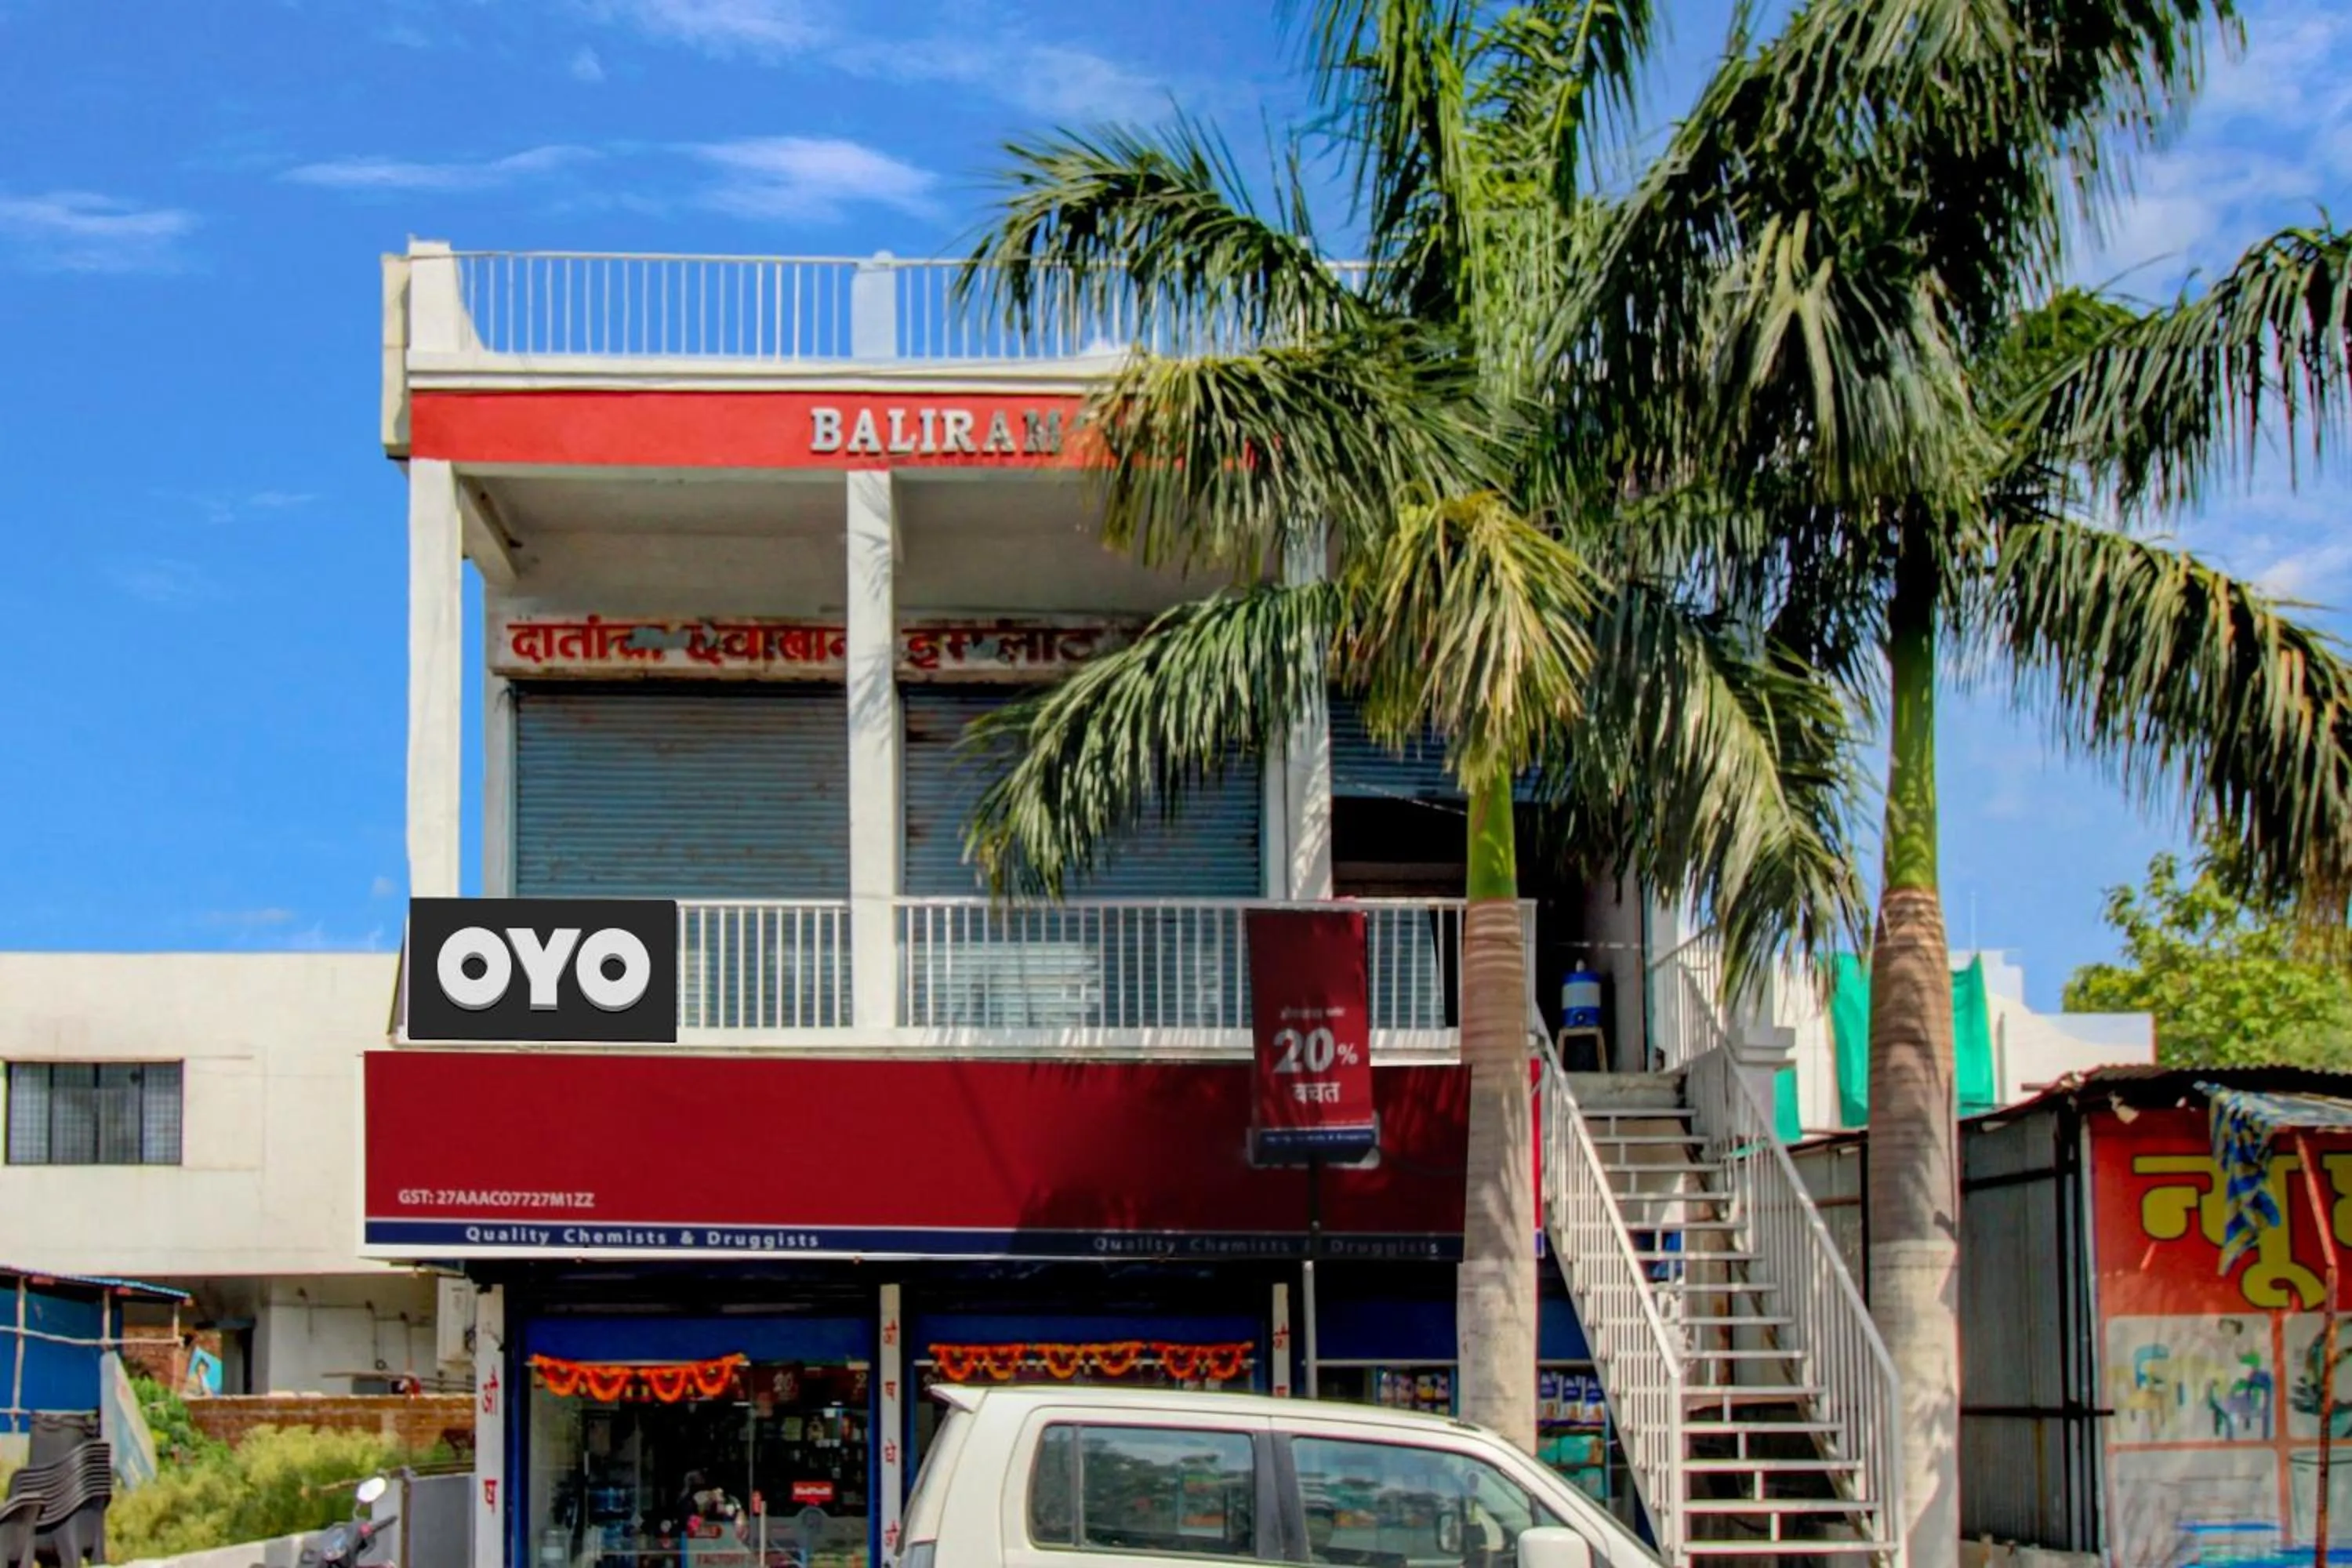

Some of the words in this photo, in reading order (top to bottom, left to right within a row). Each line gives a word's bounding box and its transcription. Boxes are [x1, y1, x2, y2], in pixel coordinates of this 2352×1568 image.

[810, 408, 1063, 456] BALIRAM
[437, 926, 652, 1013] OYO
[1272, 1026, 1359, 1073] 20%
[1291, 1081, 1341, 1105] बचत
[397, 1189, 434, 1205] GST:
[465, 1226, 550, 1246] Quality
[563, 1227, 667, 1245] Chemists
[680, 1229, 695, 1245] &
[707, 1230, 820, 1250] Druggists
[1094, 1236, 1177, 1254] Quality
[1189, 1236, 1291, 1254] Chemists
[1330, 1238, 1439, 1257] Druggists
